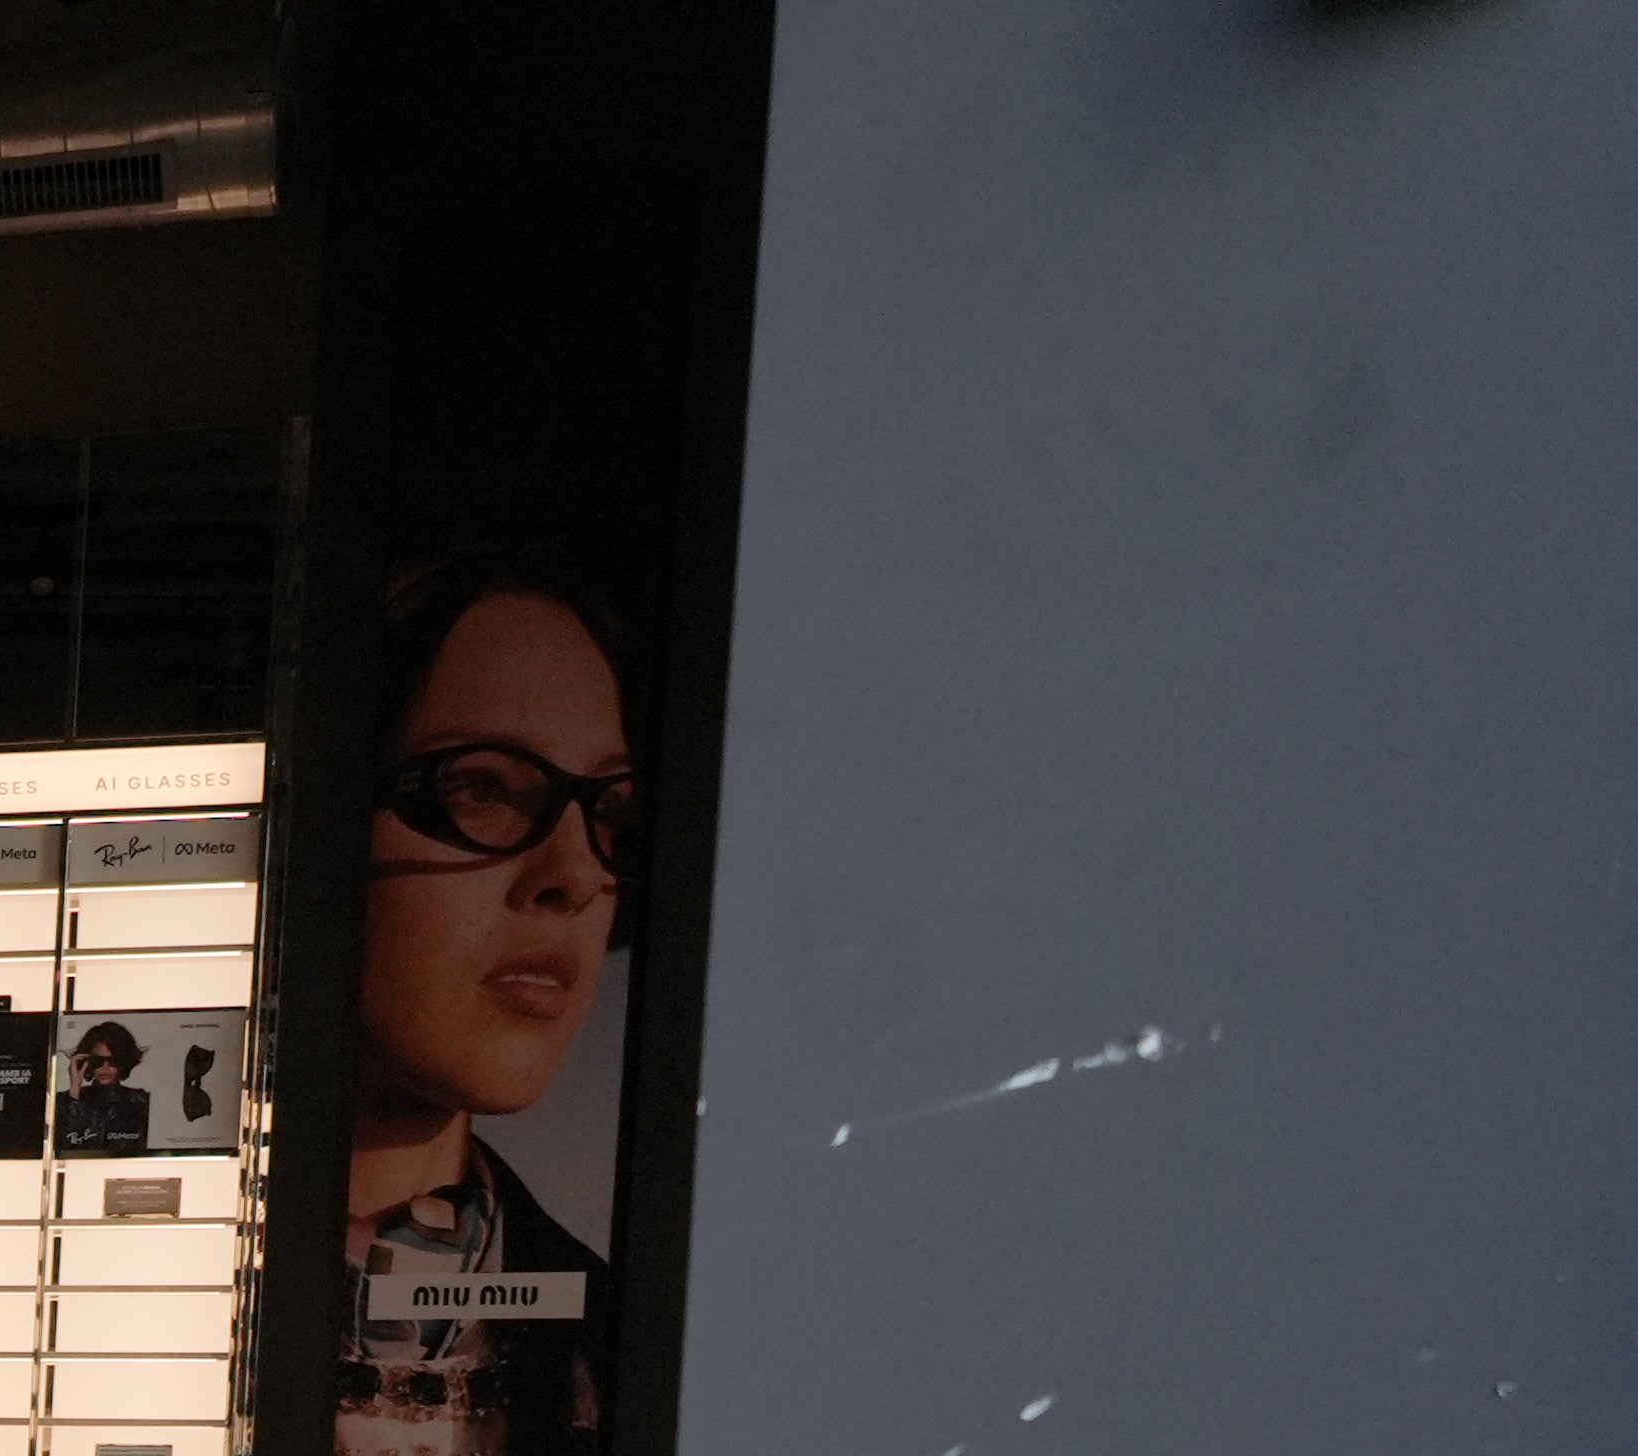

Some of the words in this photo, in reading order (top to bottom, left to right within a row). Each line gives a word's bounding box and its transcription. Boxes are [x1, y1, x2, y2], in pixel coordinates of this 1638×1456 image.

[95, 777, 117, 791] AI
[128, 772, 232, 790] GLASSES
[0, 848, 37, 860] Meta
[94, 836, 152, 868] Ray-Ban
[196, 842, 236, 856] Meta
